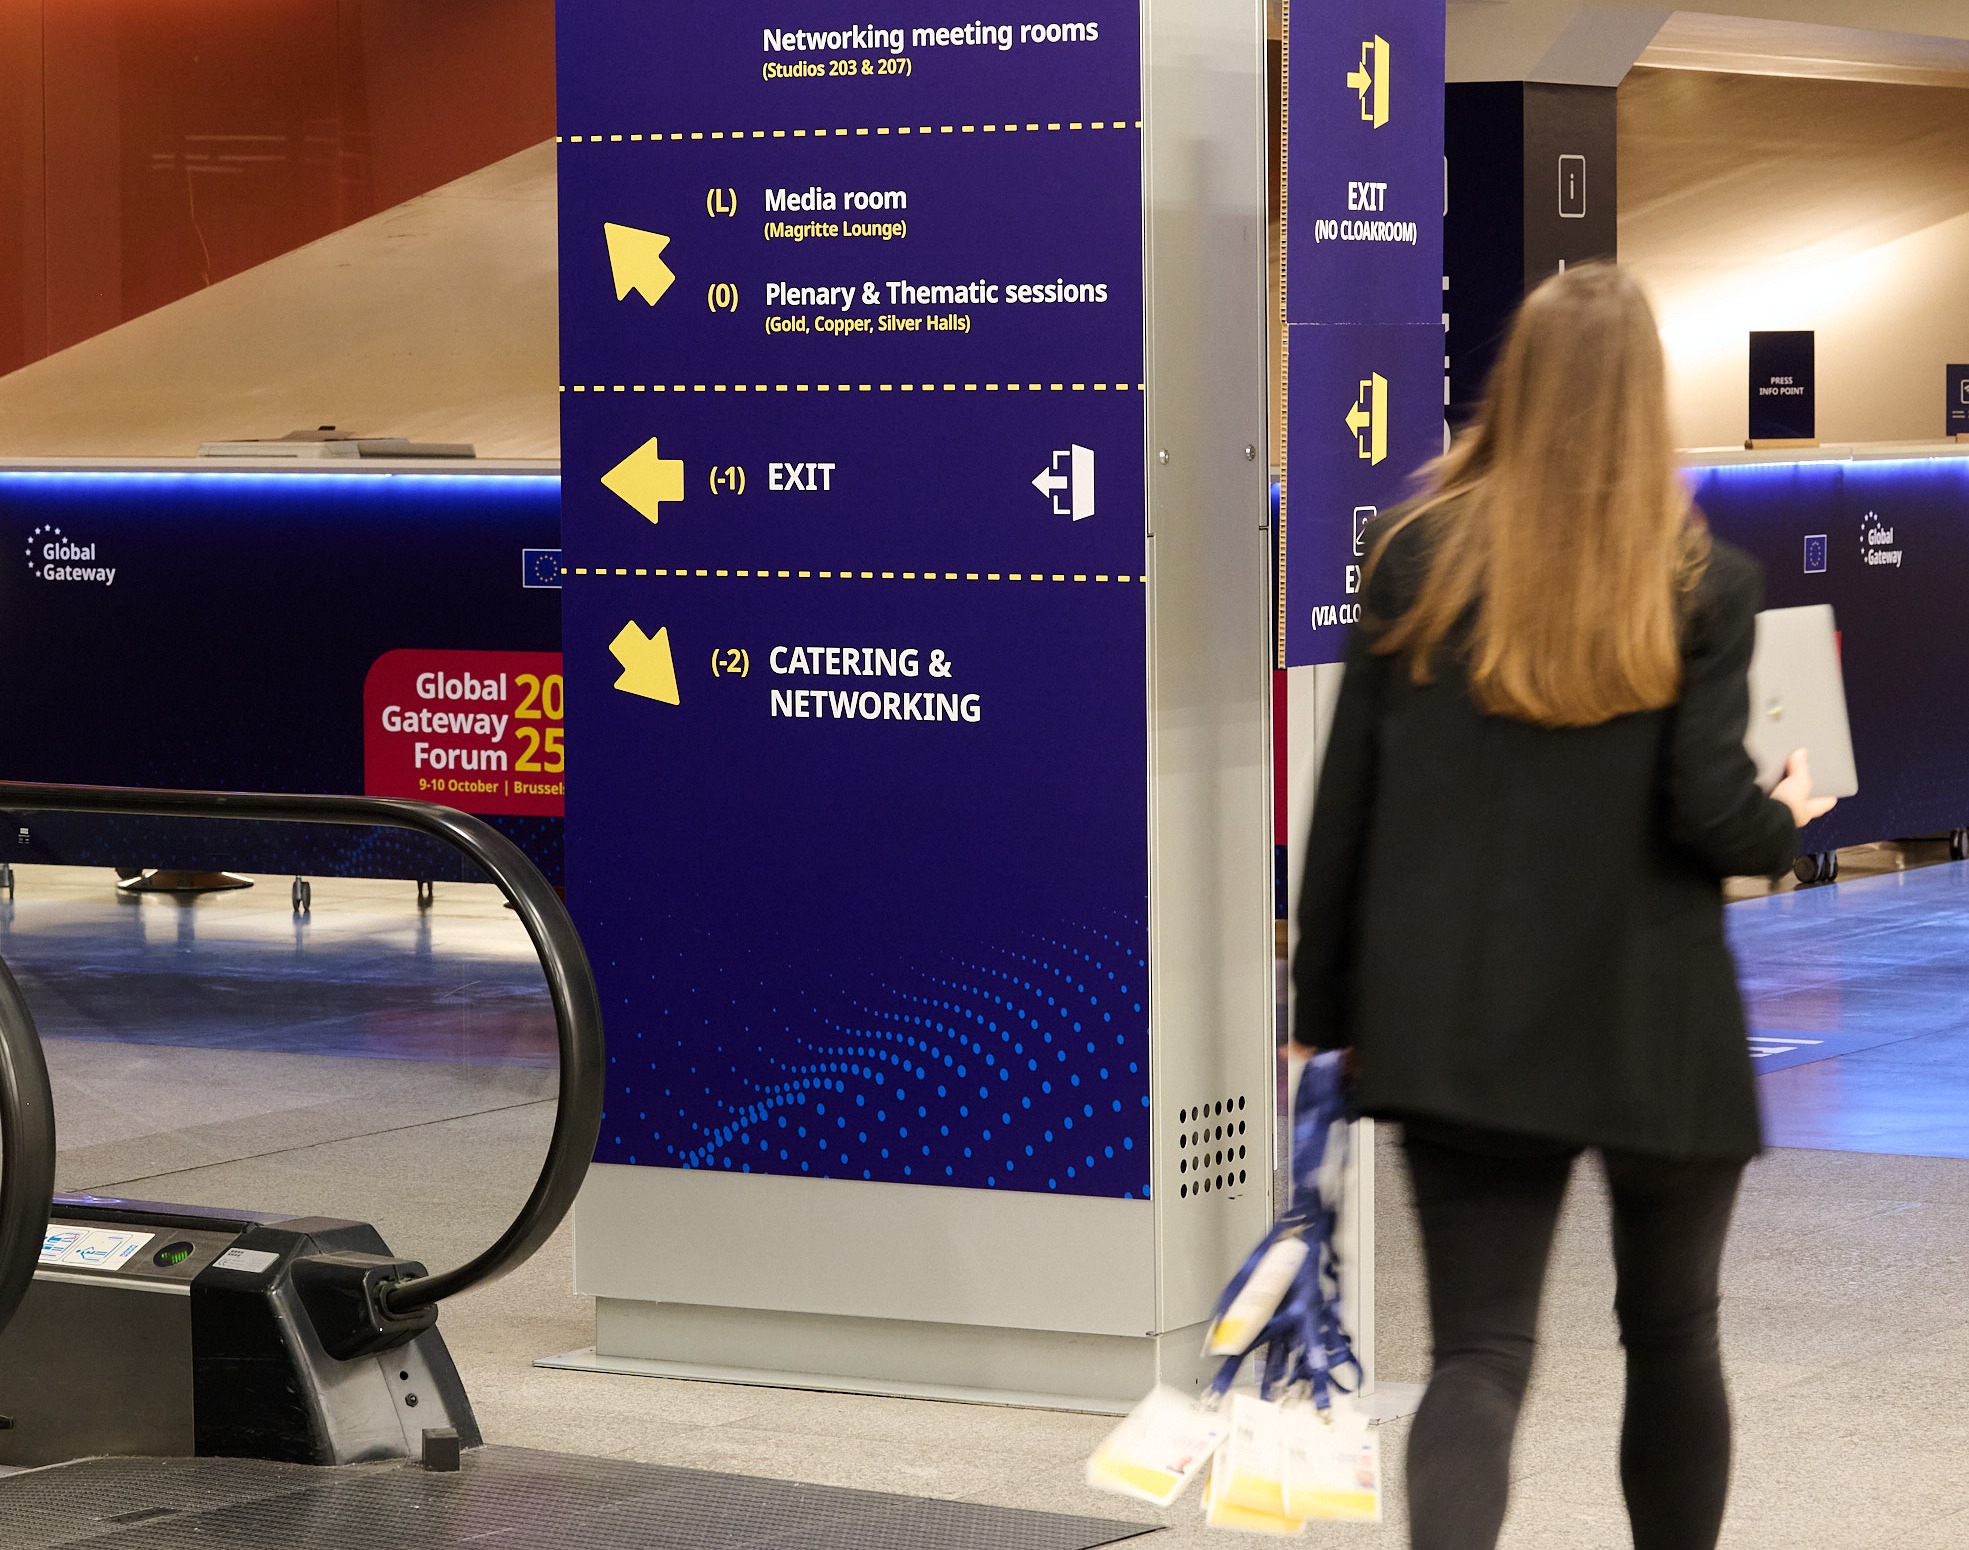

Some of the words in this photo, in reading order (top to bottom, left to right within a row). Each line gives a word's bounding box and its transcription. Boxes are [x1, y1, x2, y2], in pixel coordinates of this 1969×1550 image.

[764, 24, 904, 54] Networking
[913, 21, 1012, 50] meeting
[1018, 22, 1099, 43] rooms
[763, 61, 825, 81] (Studios
[829, 60, 857, 76] 203
[861, 59, 874, 75] &
[878, 58, 911, 76] 207)
[707, 188, 736, 217] (L)
[766, 187, 836, 211] Media
[844, 191, 906, 210] room
[1348, 182, 1387, 211] EXIT
[765, 221, 838, 241] (Magritte
[843, 220, 906, 240] Lounge)
[1315, 220, 1338, 243] (NO
[1341, 220, 1417, 245] CLOAKROOM)
[708, 284, 738, 312] (0)
[767, 282, 856, 309] Plenary
[862, 282, 880, 304] &
[886, 279, 998, 304] Thematic
[1006, 278, 1107, 303] sessions
[766, 316, 810, 334] (Gold,
[815, 316, 873, 336] Copper,
[878, 315, 922, 331] Silver
[927, 314, 970, 333] Halls)
[1760, 387, 1778, 396] INFO
[1780, 386, 1804, 396] POINT
[1770, 376, 1794, 385] PRESS
[710, 466, 745, 495] (-1)
[769, 463, 835, 490] EXIT
[1868, 527, 1893, 545] Global
[44, 542, 95, 560] Global
[1867, 549, 1902, 567] Gateway
[44, 564, 115, 585] Gateway
[1312, 605, 1337, 630] (VIA
[1339, 603, 1361, 624] CLO
[712, 649, 749, 677] (-2)
[770, 646, 918, 676] CATERING
[929, 649, 952, 678] &
[416, 672, 506, 700] Global
[515, 674, 563, 720] 20
[771, 690, 980, 722] NETWORKING
[382, 706, 508, 743] Gateway
[415, 742, 507, 771] Forum
[515, 727, 564, 773] 25
[419, 778, 445, 791] 9-10
[448, 779, 498, 792] October
